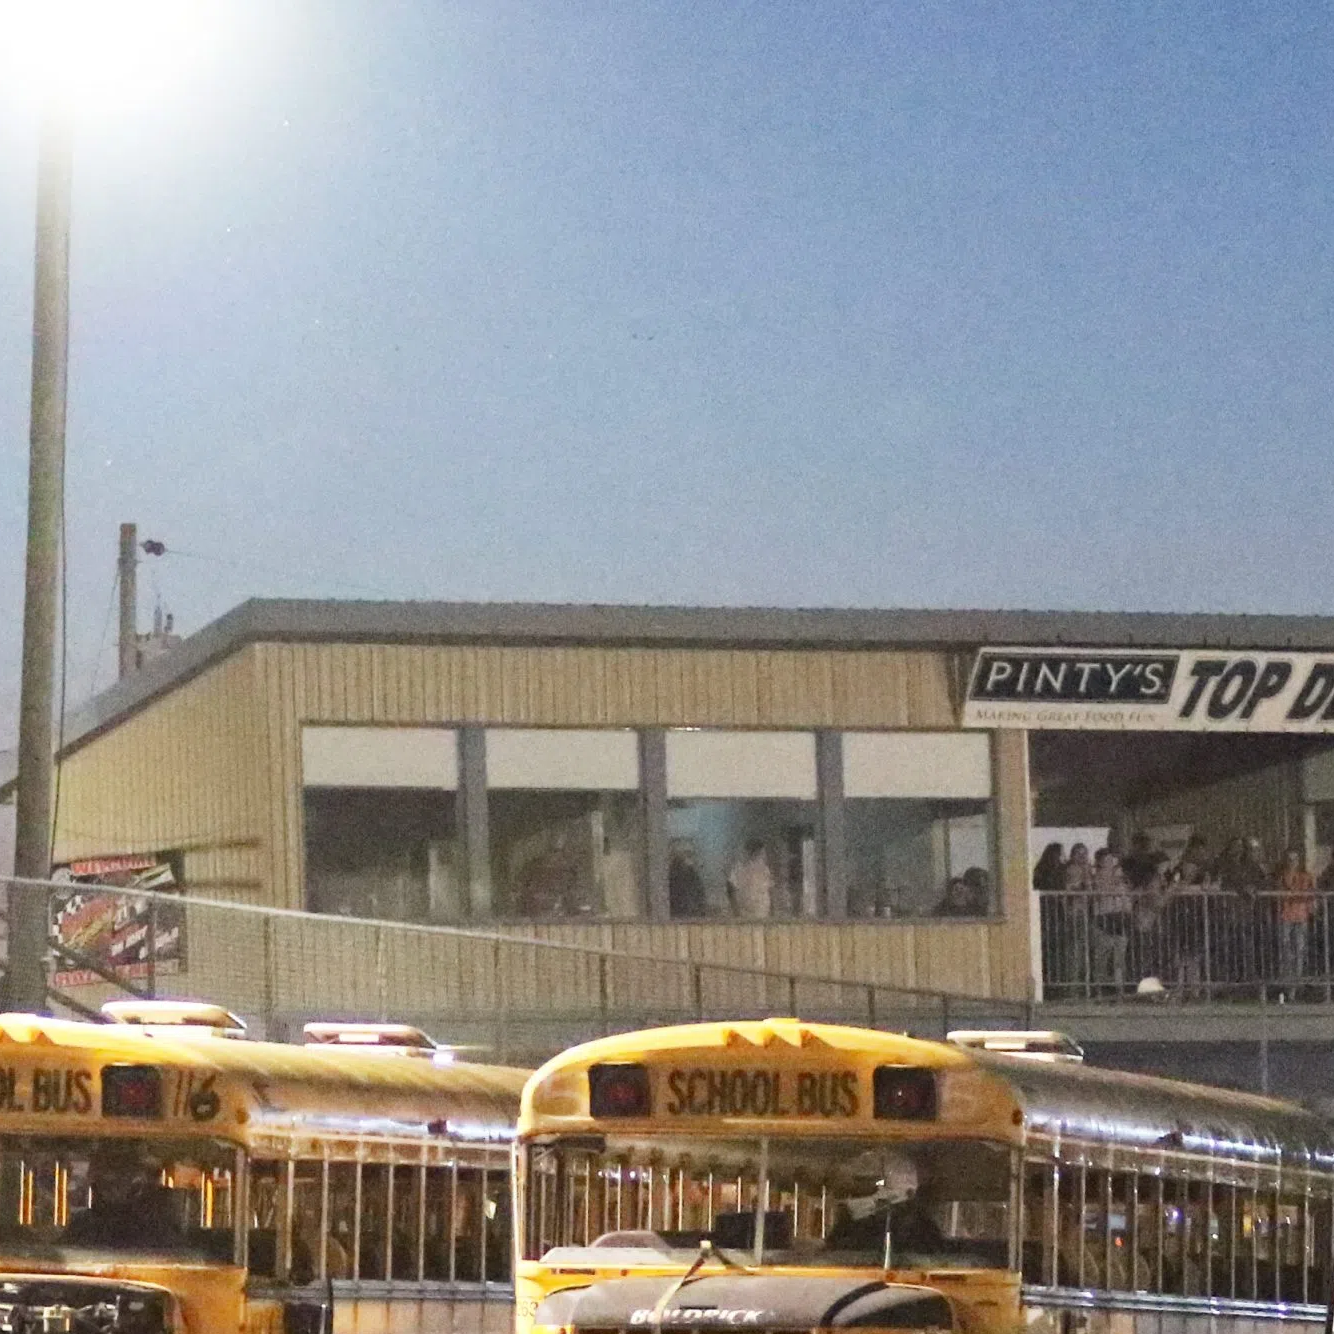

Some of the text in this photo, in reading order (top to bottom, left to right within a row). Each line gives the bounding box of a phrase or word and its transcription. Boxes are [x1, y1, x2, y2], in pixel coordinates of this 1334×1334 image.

[985, 661, 1165, 694] PINTY'S
[1178, 659, 1293, 720] TOP
[976, 709, 1031, 720] MAKING
[1036, 709, 1078, 721] GREAT
[31, 1067, 93, 1116] BUS
[667, 1066, 859, 1119] SCHOOL BUS
